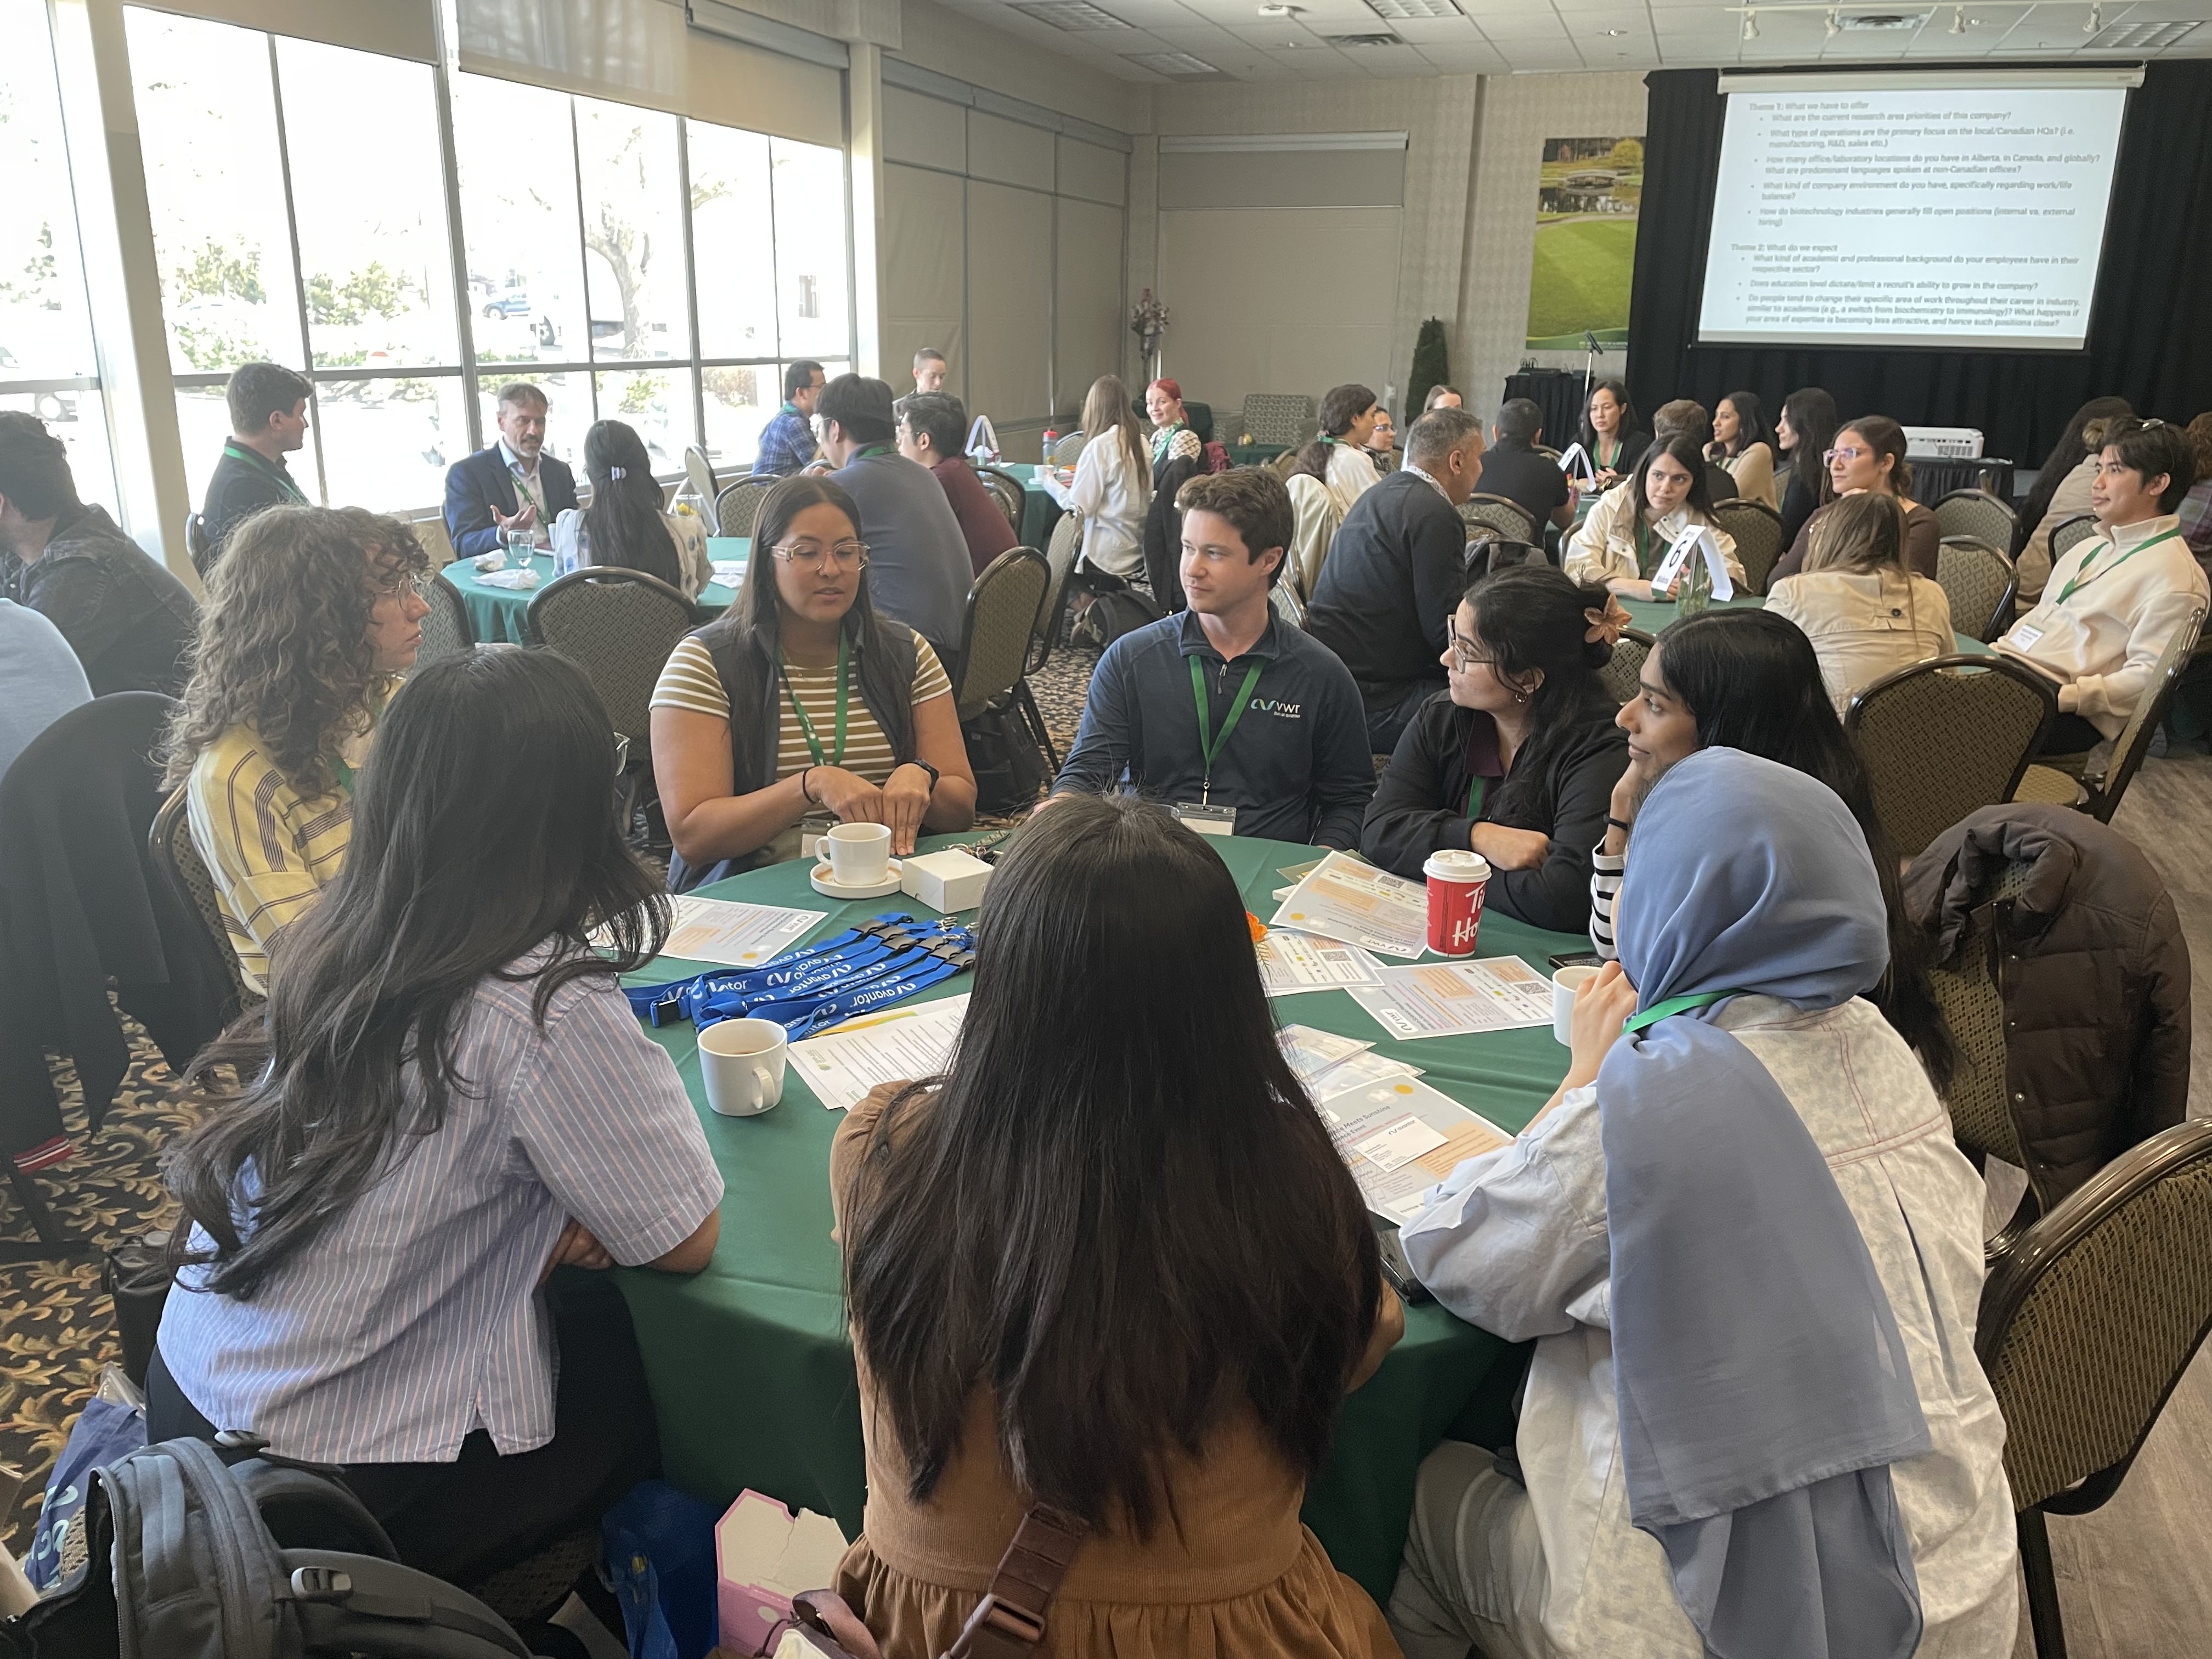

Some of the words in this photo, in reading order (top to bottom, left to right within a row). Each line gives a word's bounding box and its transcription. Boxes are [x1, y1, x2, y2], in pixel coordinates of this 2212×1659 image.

[1669, 540, 1688, 568] 6
[1465, 881, 1487, 914] Ti
[789, 973, 831, 994] avantor
[853, 988, 896, 1007] avantor
[1343, 1117, 1364, 1129] Meets
[1362, 1105, 1391, 1120] Sunshine
